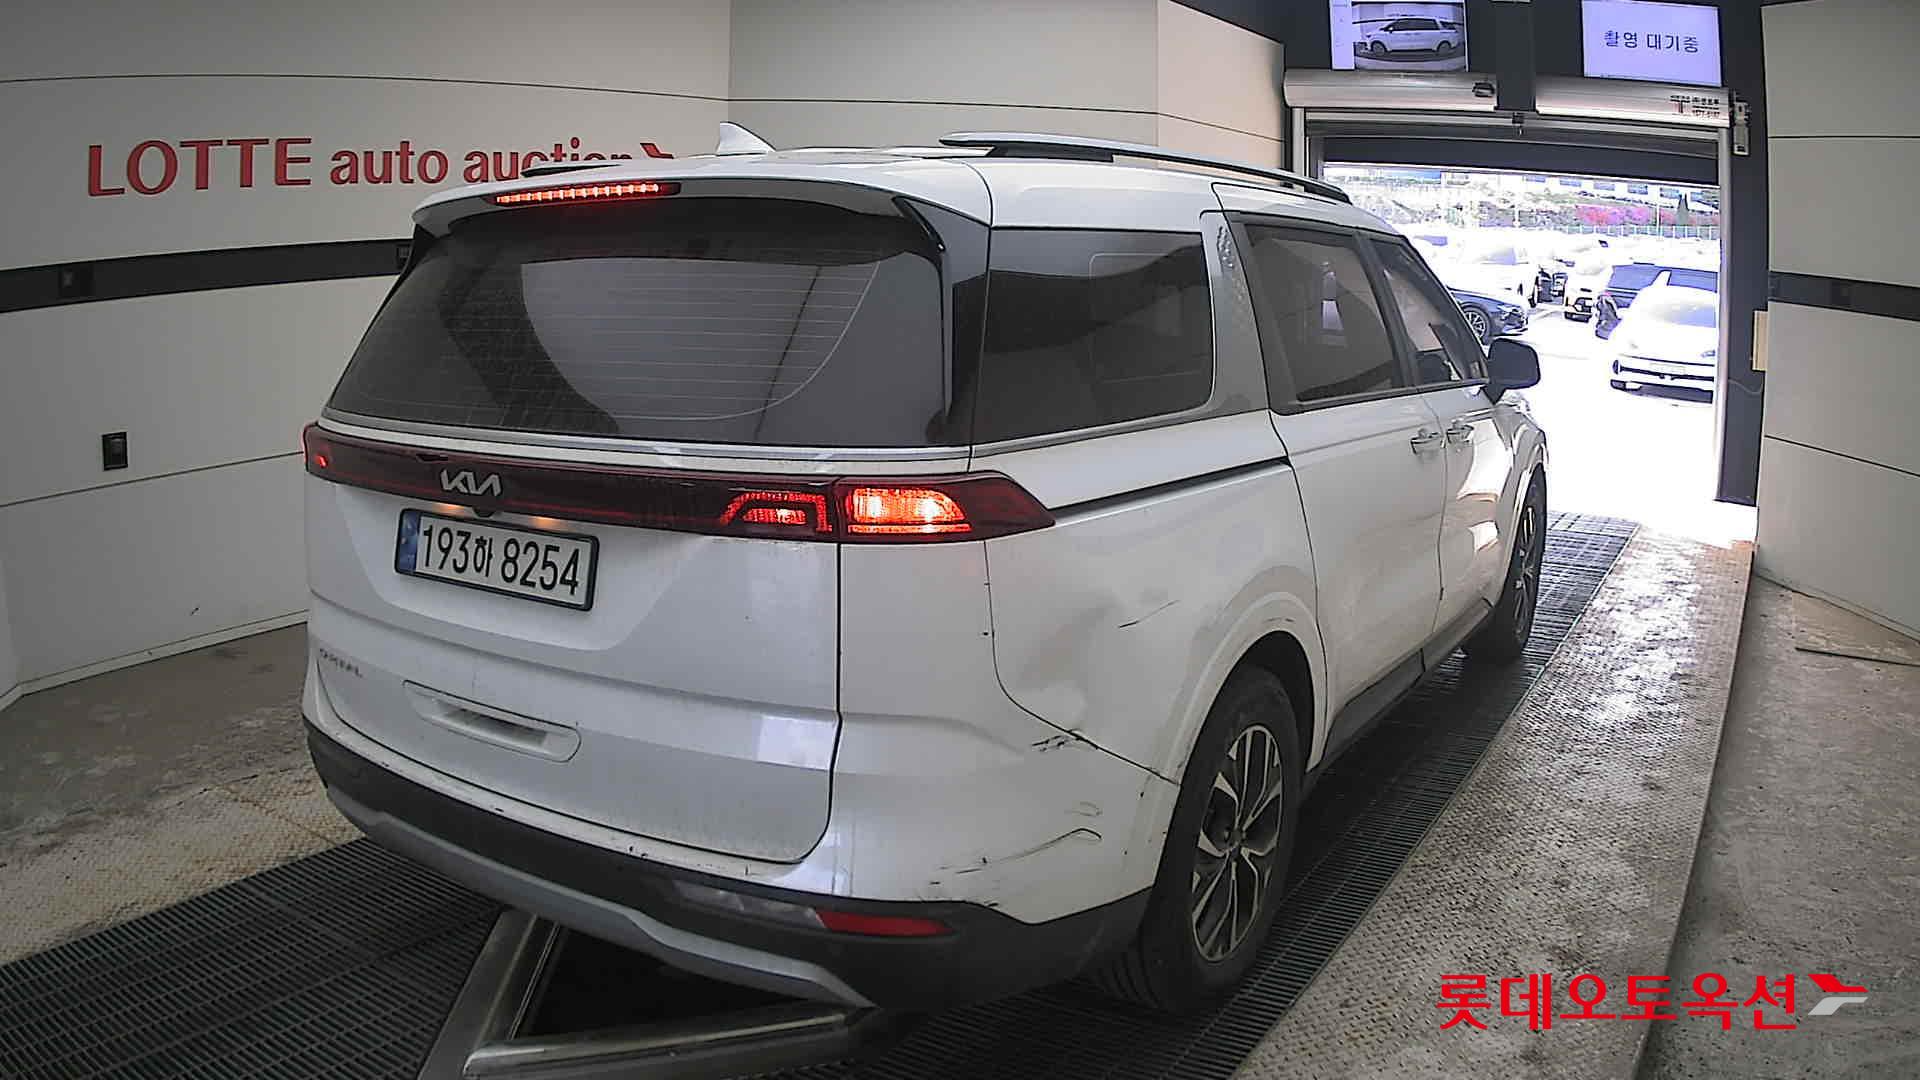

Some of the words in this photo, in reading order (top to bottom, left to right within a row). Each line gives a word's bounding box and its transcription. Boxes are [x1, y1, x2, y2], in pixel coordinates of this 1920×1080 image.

[1604, 30, 1638, 49] 촬영
[1647, 33, 1699, 53] 대기중
[88, 138, 312, 197] LOTTE
[329, 140, 448, 185] auto
[440, 469, 502, 496] KIA
[422, 524, 493, 577] 193하
[501, 538, 580, 596] 8254
